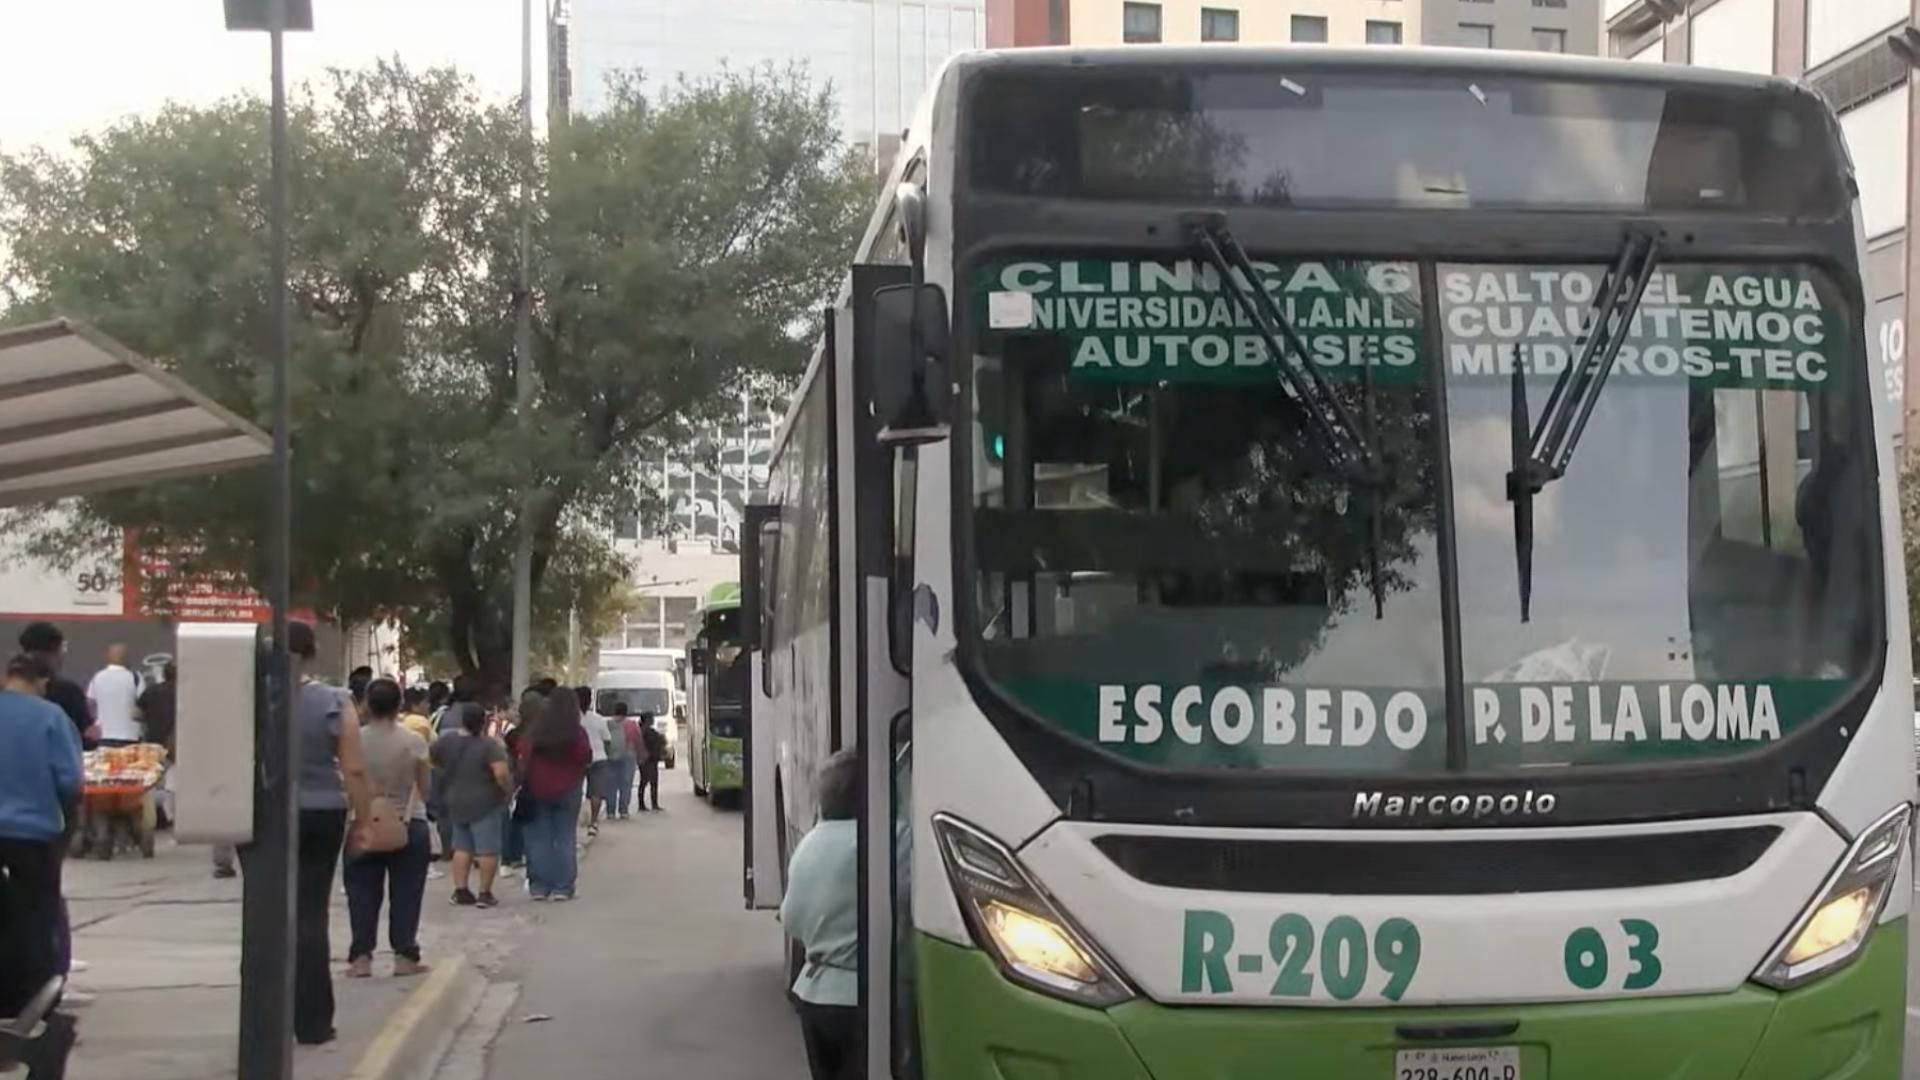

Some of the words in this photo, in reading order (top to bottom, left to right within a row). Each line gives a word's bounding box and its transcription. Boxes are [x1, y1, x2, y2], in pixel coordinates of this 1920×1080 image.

[1000, 261, 1341, 294] CLINICA
[1368, 262, 1413, 294] 6
[1445, 271, 1593, 303] SALTO
[1704, 276, 1822, 310] AGUA
[1029, 296, 1262, 330] NIVERSIDAD
[1098, 685, 1428, 750] ESCOBEDO
[1472, 686, 1507, 744] P.
[1519, 686, 1576, 743] DE
[1588, 684, 1648, 742] LA
[1658, 683, 1781, 741] LOMA
[1351, 791, 1556, 819] Marcopolo
[1181, 908, 1422, 1001] R-209
